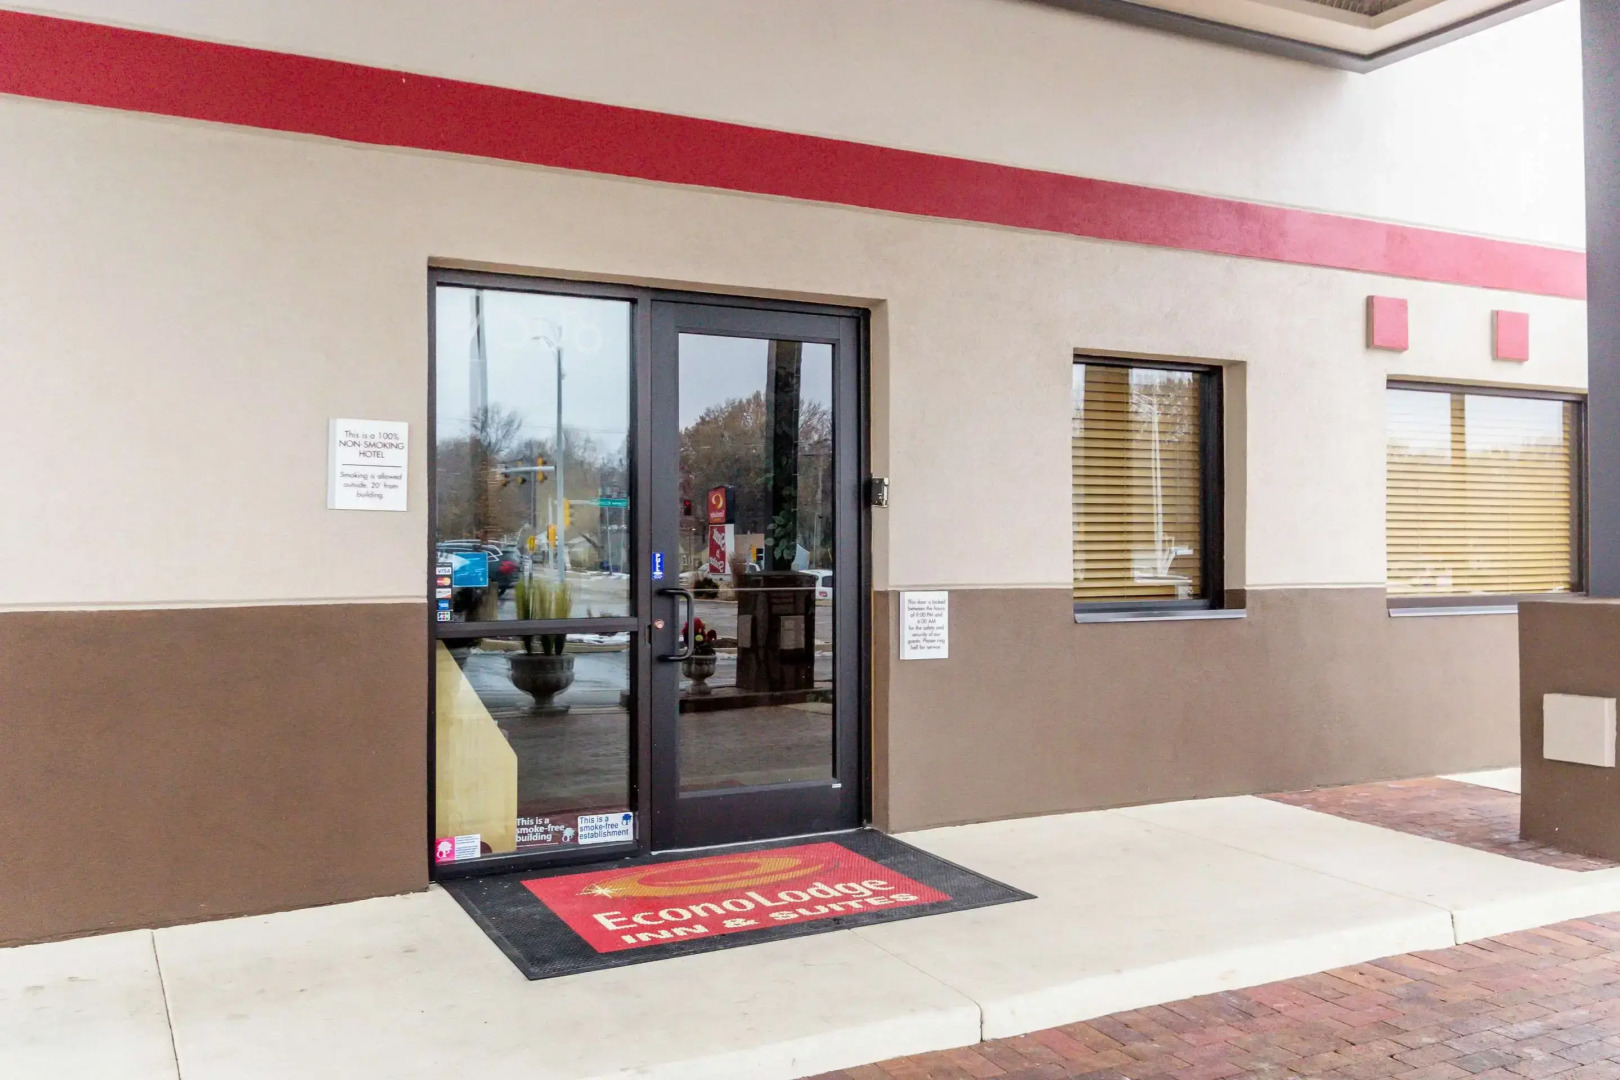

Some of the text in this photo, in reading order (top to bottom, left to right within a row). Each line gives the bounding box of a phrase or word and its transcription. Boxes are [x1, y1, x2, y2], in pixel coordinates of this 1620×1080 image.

[379, 432, 400, 440] 100%
[359, 451, 385, 459] HOTEL
[340, 472, 368, 480] Smoking
[516, 817, 534, 826] This
[579, 816, 595, 824] This
[516, 824, 565, 833] smoke-free
[580, 823, 619, 832] smoke-free
[516, 833, 552, 842] building
[579, 829, 629, 840] establishment
[621, 893, 920, 945] INN & SUITES
